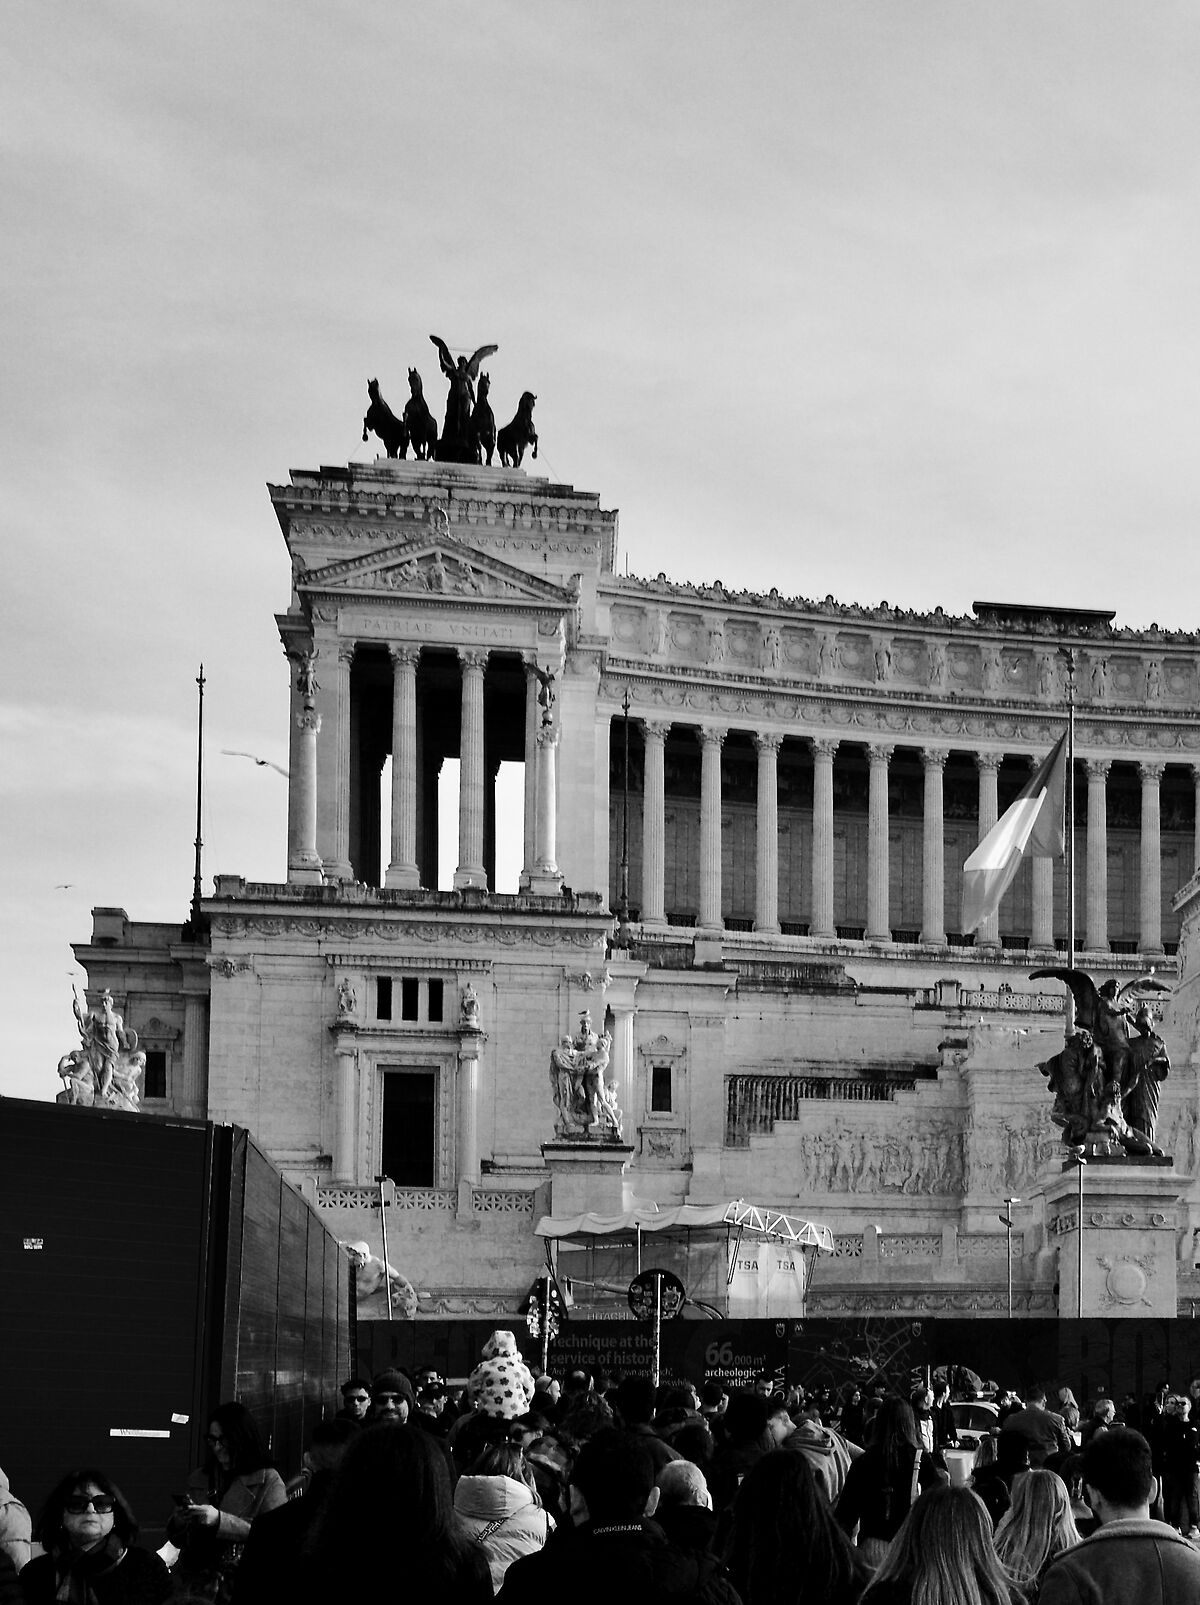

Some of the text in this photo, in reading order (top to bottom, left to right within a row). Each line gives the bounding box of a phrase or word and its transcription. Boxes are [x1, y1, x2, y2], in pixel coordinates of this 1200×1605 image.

[364, 619, 433, 634] PATRIAE
[737, 1260, 759, 1271] TSA
[776, 1260, 796, 1272] TSA
[619, 1336, 633, 1348] at
[635, 1334, 655, 1348] the
[550, 1351, 596, 1365] service
[598, 1350, 612, 1365] of
[705, 1341, 752, 1367] 66,000
